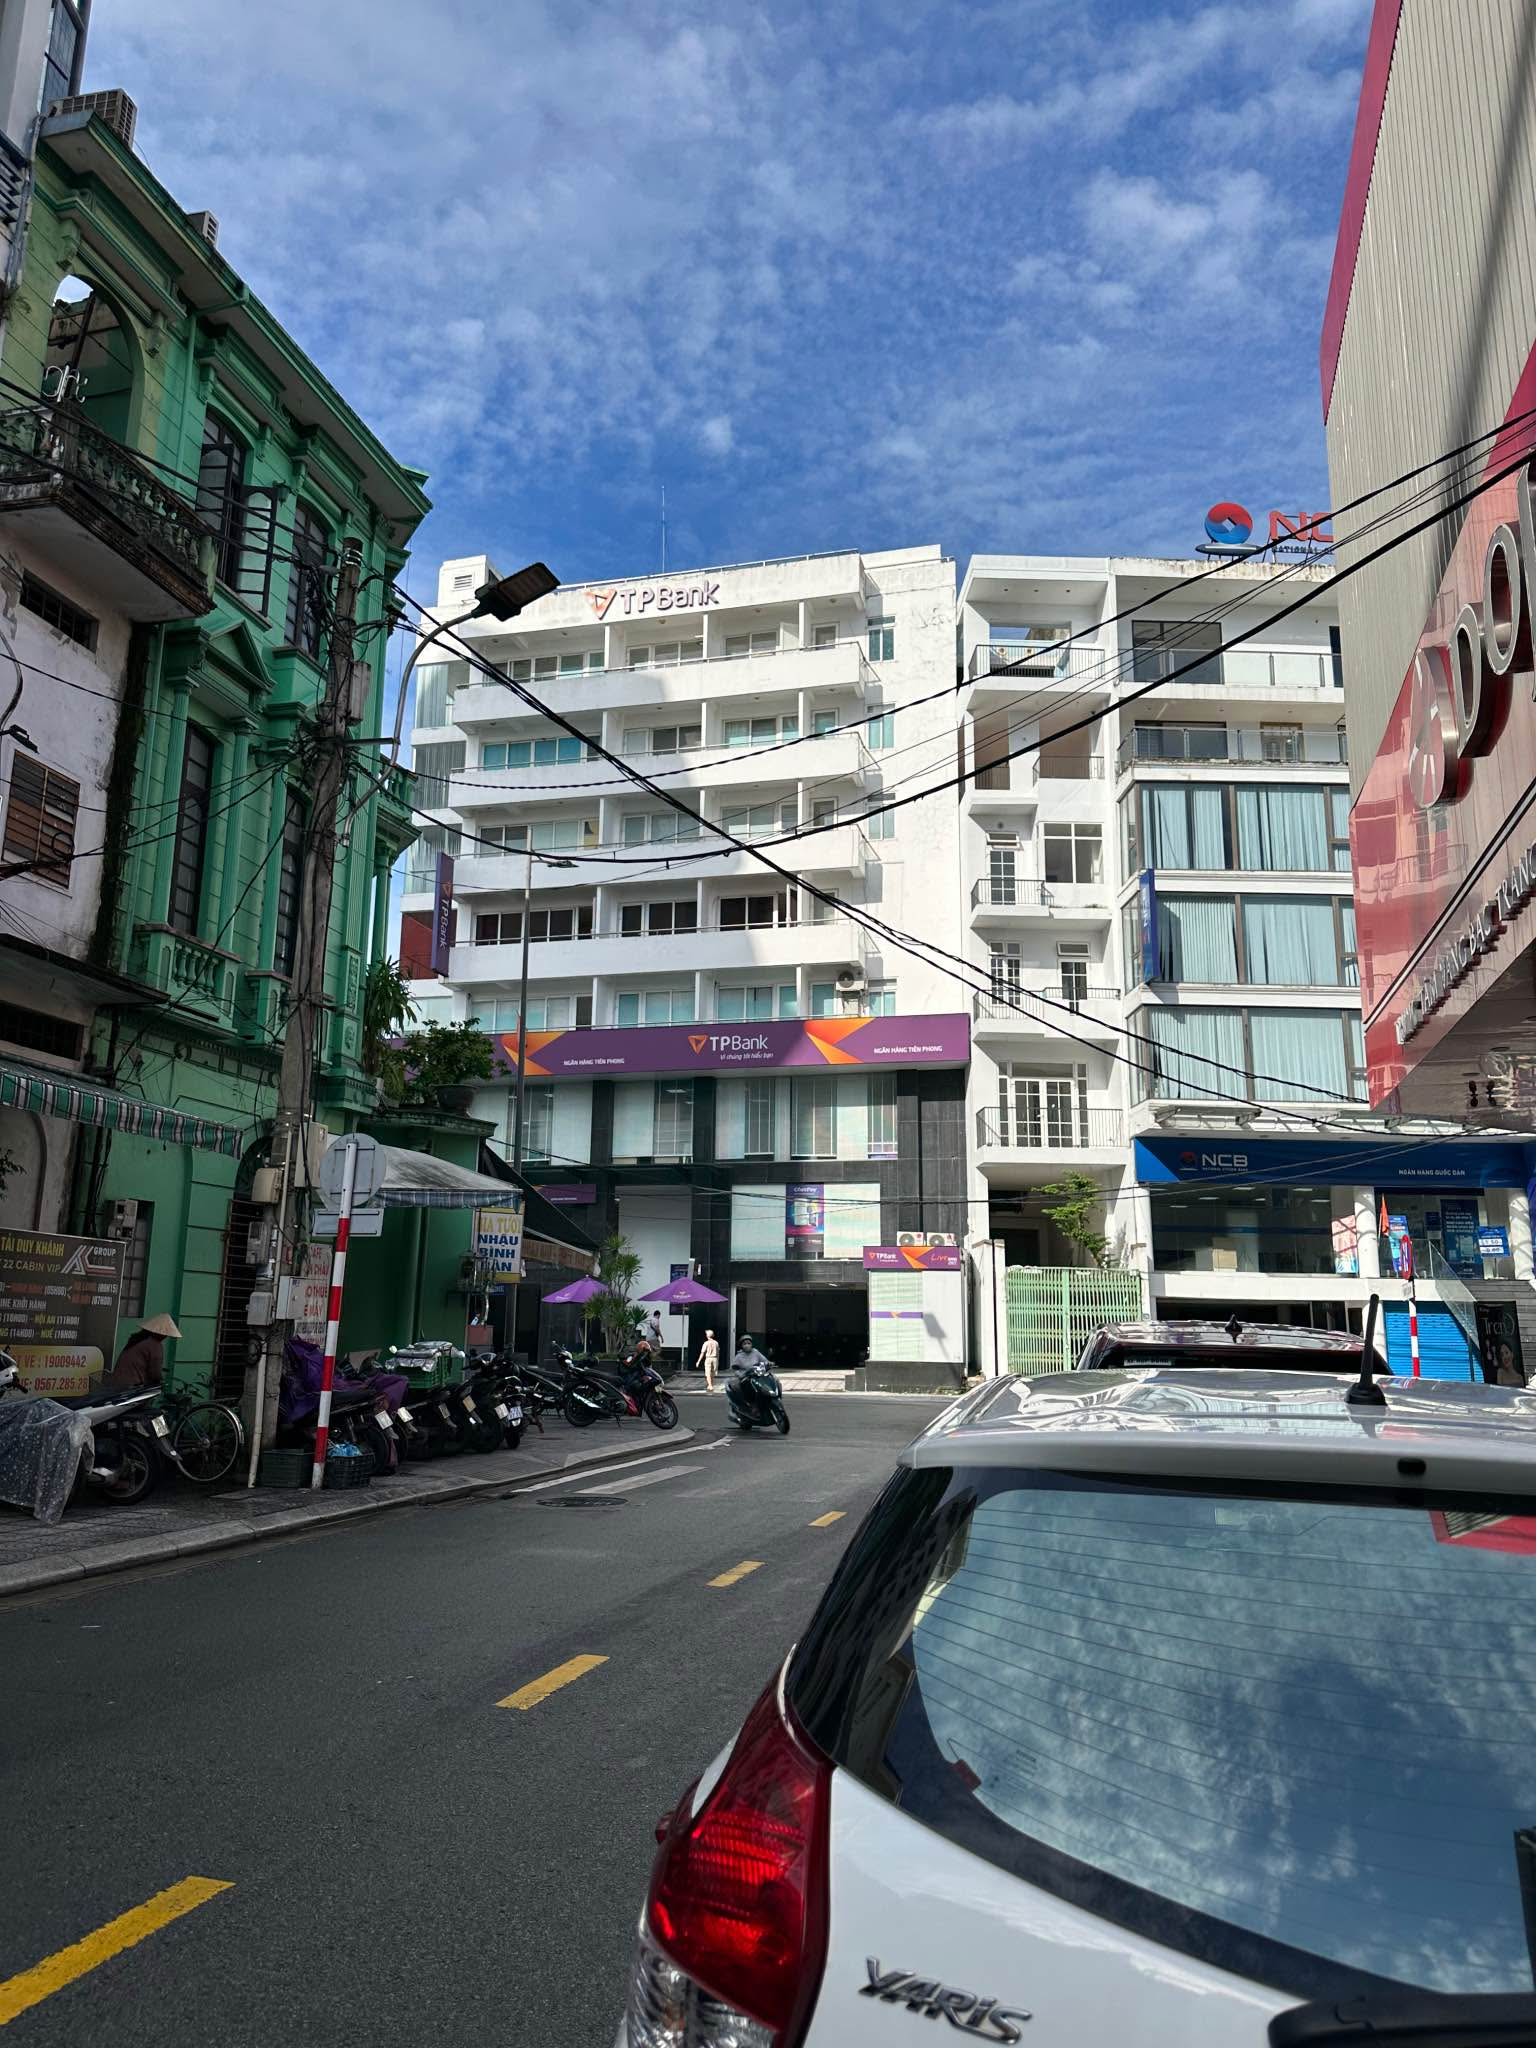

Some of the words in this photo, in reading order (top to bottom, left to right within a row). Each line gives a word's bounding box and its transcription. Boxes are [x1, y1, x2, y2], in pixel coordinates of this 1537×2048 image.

[620, 582, 720, 614] TPBank
[440, 899, 450, 951] TPBank
[710, 1034, 768, 1052] TPBank
[1202, 1154, 1248, 1167] NCB
[2, 1234, 15, 1252] TẢI
[17, 1239, 34, 1254] DUY
[35, 1240, 65, 1257] KHÁNH
[479, 1233, 519, 1247] NHẬU
[94, 1247, 117, 1256] GROUP
[480, 1246, 516, 1259] BÌNH
[3, 1259, 13, 1269] 22
[15, 1261, 45, 1271] CABIN
[47, 1264, 61, 1273] VIP
